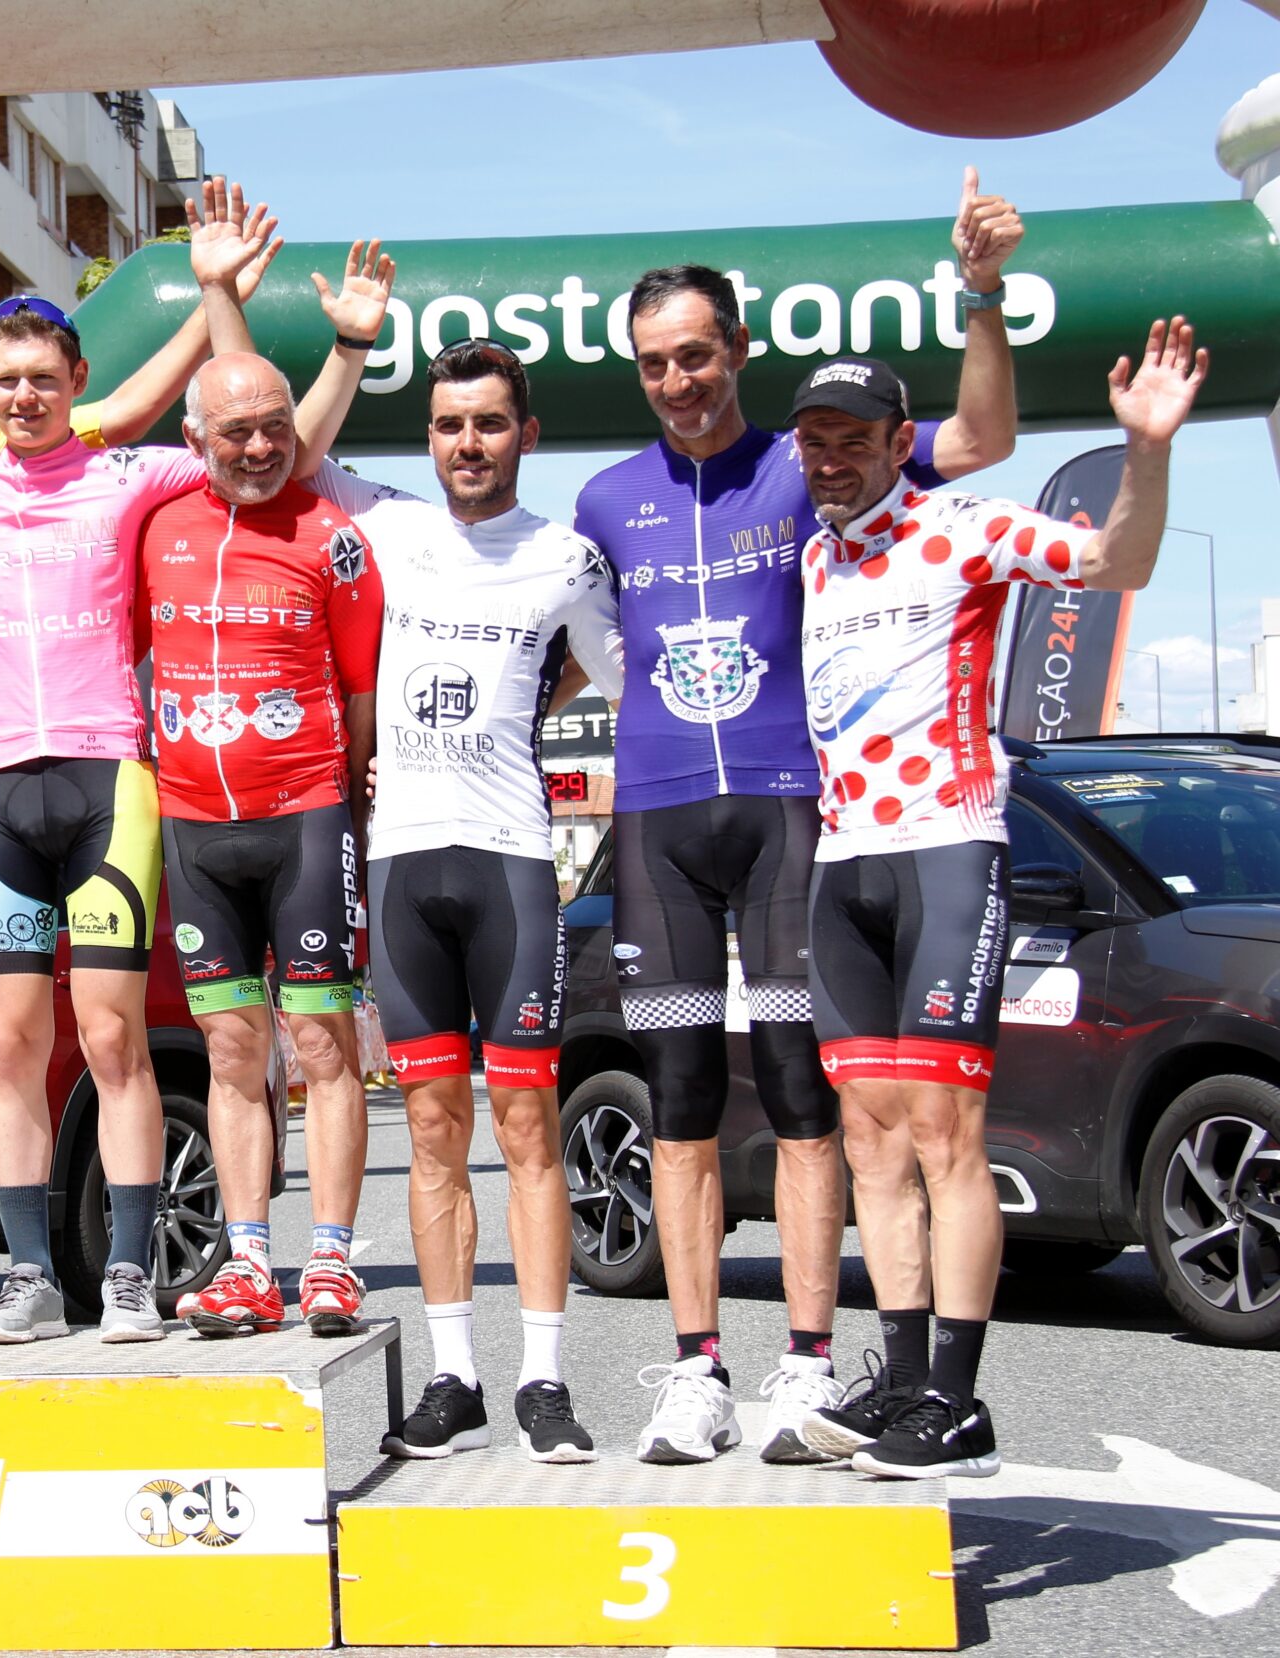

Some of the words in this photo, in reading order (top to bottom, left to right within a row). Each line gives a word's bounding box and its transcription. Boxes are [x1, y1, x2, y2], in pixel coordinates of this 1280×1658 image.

[625, 517, 635, 528] di
[637, 516, 669, 529] garda
[729, 525, 772, 554] VOLTA
[778, 516, 795, 543] AO
[247, 585, 288, 606] VOLTA
[173, 671, 196, 680] Santa
[238, 670, 280, 679] Meixedo
[185, 662, 199, 670] das
[1035, 588, 1083, 742] EÇÃO24H
[665, 693, 709, 721] FREGUESIA
[713, 709, 727, 720] DE
[728, 683, 757, 714] VINHAIS
[541, 713, 618, 740] ESTE
[341, 832, 358, 928] CEPSA
[961, 895, 999, 1024] SOLACÚSTICO
[987, 856, 1001, 892] Lda.
[984, 899, 1005, 988] Construções
[184, 967, 232, 981] CRUZ
[286, 971, 336, 981] CRUZ
[999, 997, 1072, 1018] AIRCROSS
[919, 1017, 956, 1027] CICLISMO
[411, 1054, 458, 1067] FISIOSOUTO
[489, 1065, 537, 1075] FISIOSOUTO
[602, 1530, 677, 1621] 3
